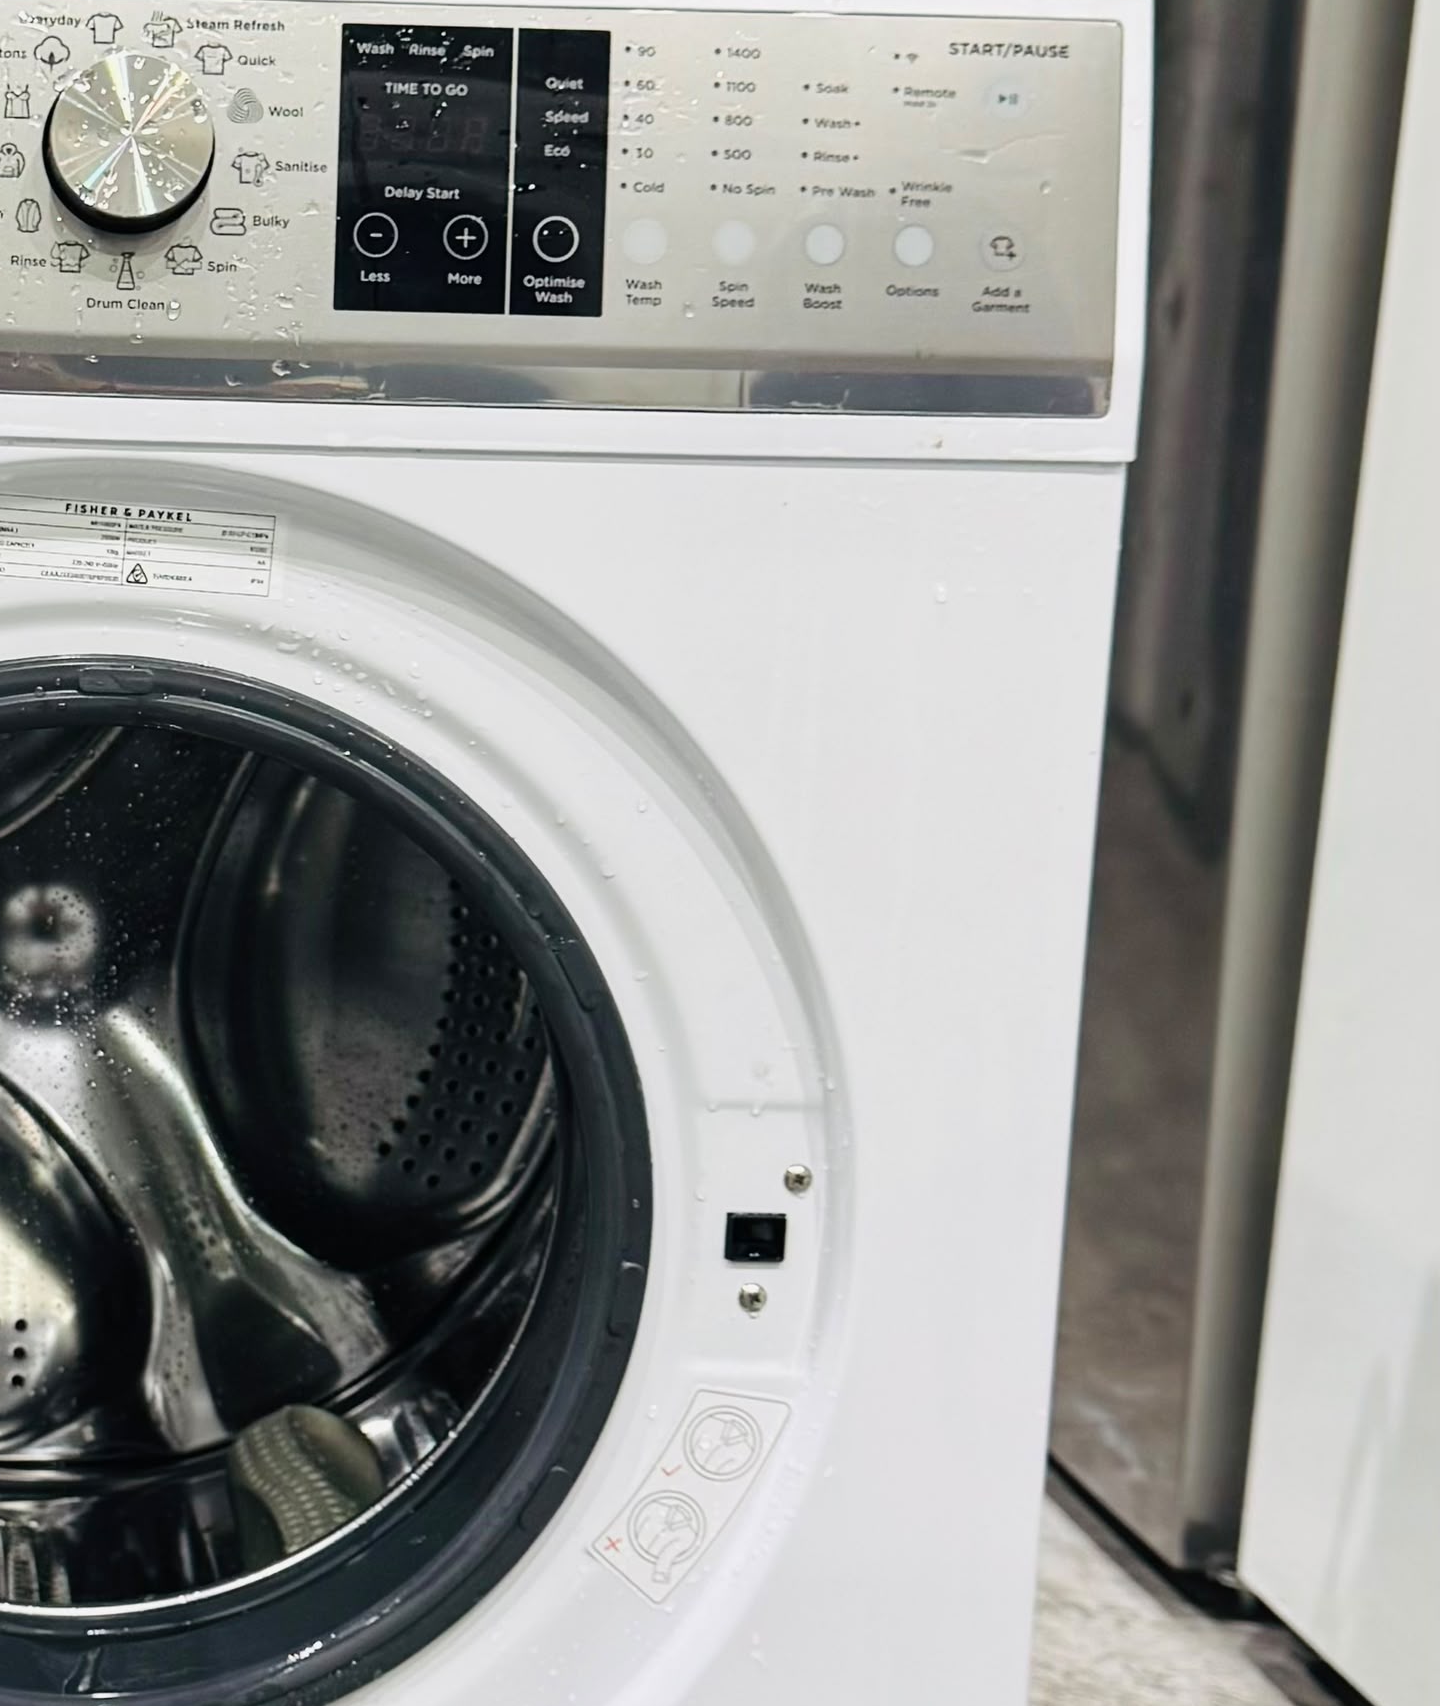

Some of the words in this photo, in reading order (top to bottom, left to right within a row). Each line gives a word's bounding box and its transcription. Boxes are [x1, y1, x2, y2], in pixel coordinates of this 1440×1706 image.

[186, 18, 229, 30] Steam
[234, 20, 285, 31] Refresh
[357, 43, 395, 55] Wash
[409, 44, 446, 57] Rinse
[463, 45, 495, 59] Spin
[638, 46, 656, 57] 90
[727, 48, 761, 59] 1400
[949, 42, 1070, 59] START/PAUSE
[238, 55, 276, 66] Quick
[385, 82, 418, 95] TIME
[423, 83, 442, 95] TO
[445, 84, 468, 96] GO
[545, 77, 584, 90] Quiet
[637, 80, 655, 91] 60
[727, 82, 756, 92] 1100
[816, 83, 849, 94] Soak
[904, 87, 956, 98] Remote
[269, 107, 304, 118] Wool
[545, 110, 589, 125] Speed
[635, 114, 654, 125] 40
[725, 115, 752, 126] 800
[544, 144, 571, 157] Eco
[636, 147, 654, 159] 30
[724, 149, 751, 160] 500
[275, 161, 328, 173] Sanitise
[633, 182, 664, 193] Cold
[722, 183, 742, 194] No
[746, 184, 775, 196] Spin
[812, 186, 834, 196] Pre
[839, 187, 875, 197] Wash
[901, 181, 952, 193] Wrinkle
[385, 186, 423, 201] Delay
[426, 187, 460, 200] Start
[901, 196, 931, 207] Free
[253, 216, 289, 229] Bulky
[11, 255, 47, 267] Rinse
[208, 261, 237, 273] Spin
[361, 270, 391, 282] Less
[448, 273, 482, 285] More
[523, 275, 585, 289] Optimise
[625, 279, 662, 290] Wash
[719, 281, 749, 293] Spin
[805, 283, 842, 294] Wash
[885, 284, 939, 297] Options
[535, 291, 573, 303] Wash
[982, 286, 1010, 297] Add
[87, 298, 122, 309] Drum
[128, 299, 164, 311] Clean
[626, 294, 662, 306] Temp
[712, 296, 755, 308] Speed
[803, 298, 842, 309] Boost
[971, 301, 1030, 313] Garment
[65, 503, 118, 515] FISHER
[138, 509, 192, 522] PAYKEL
